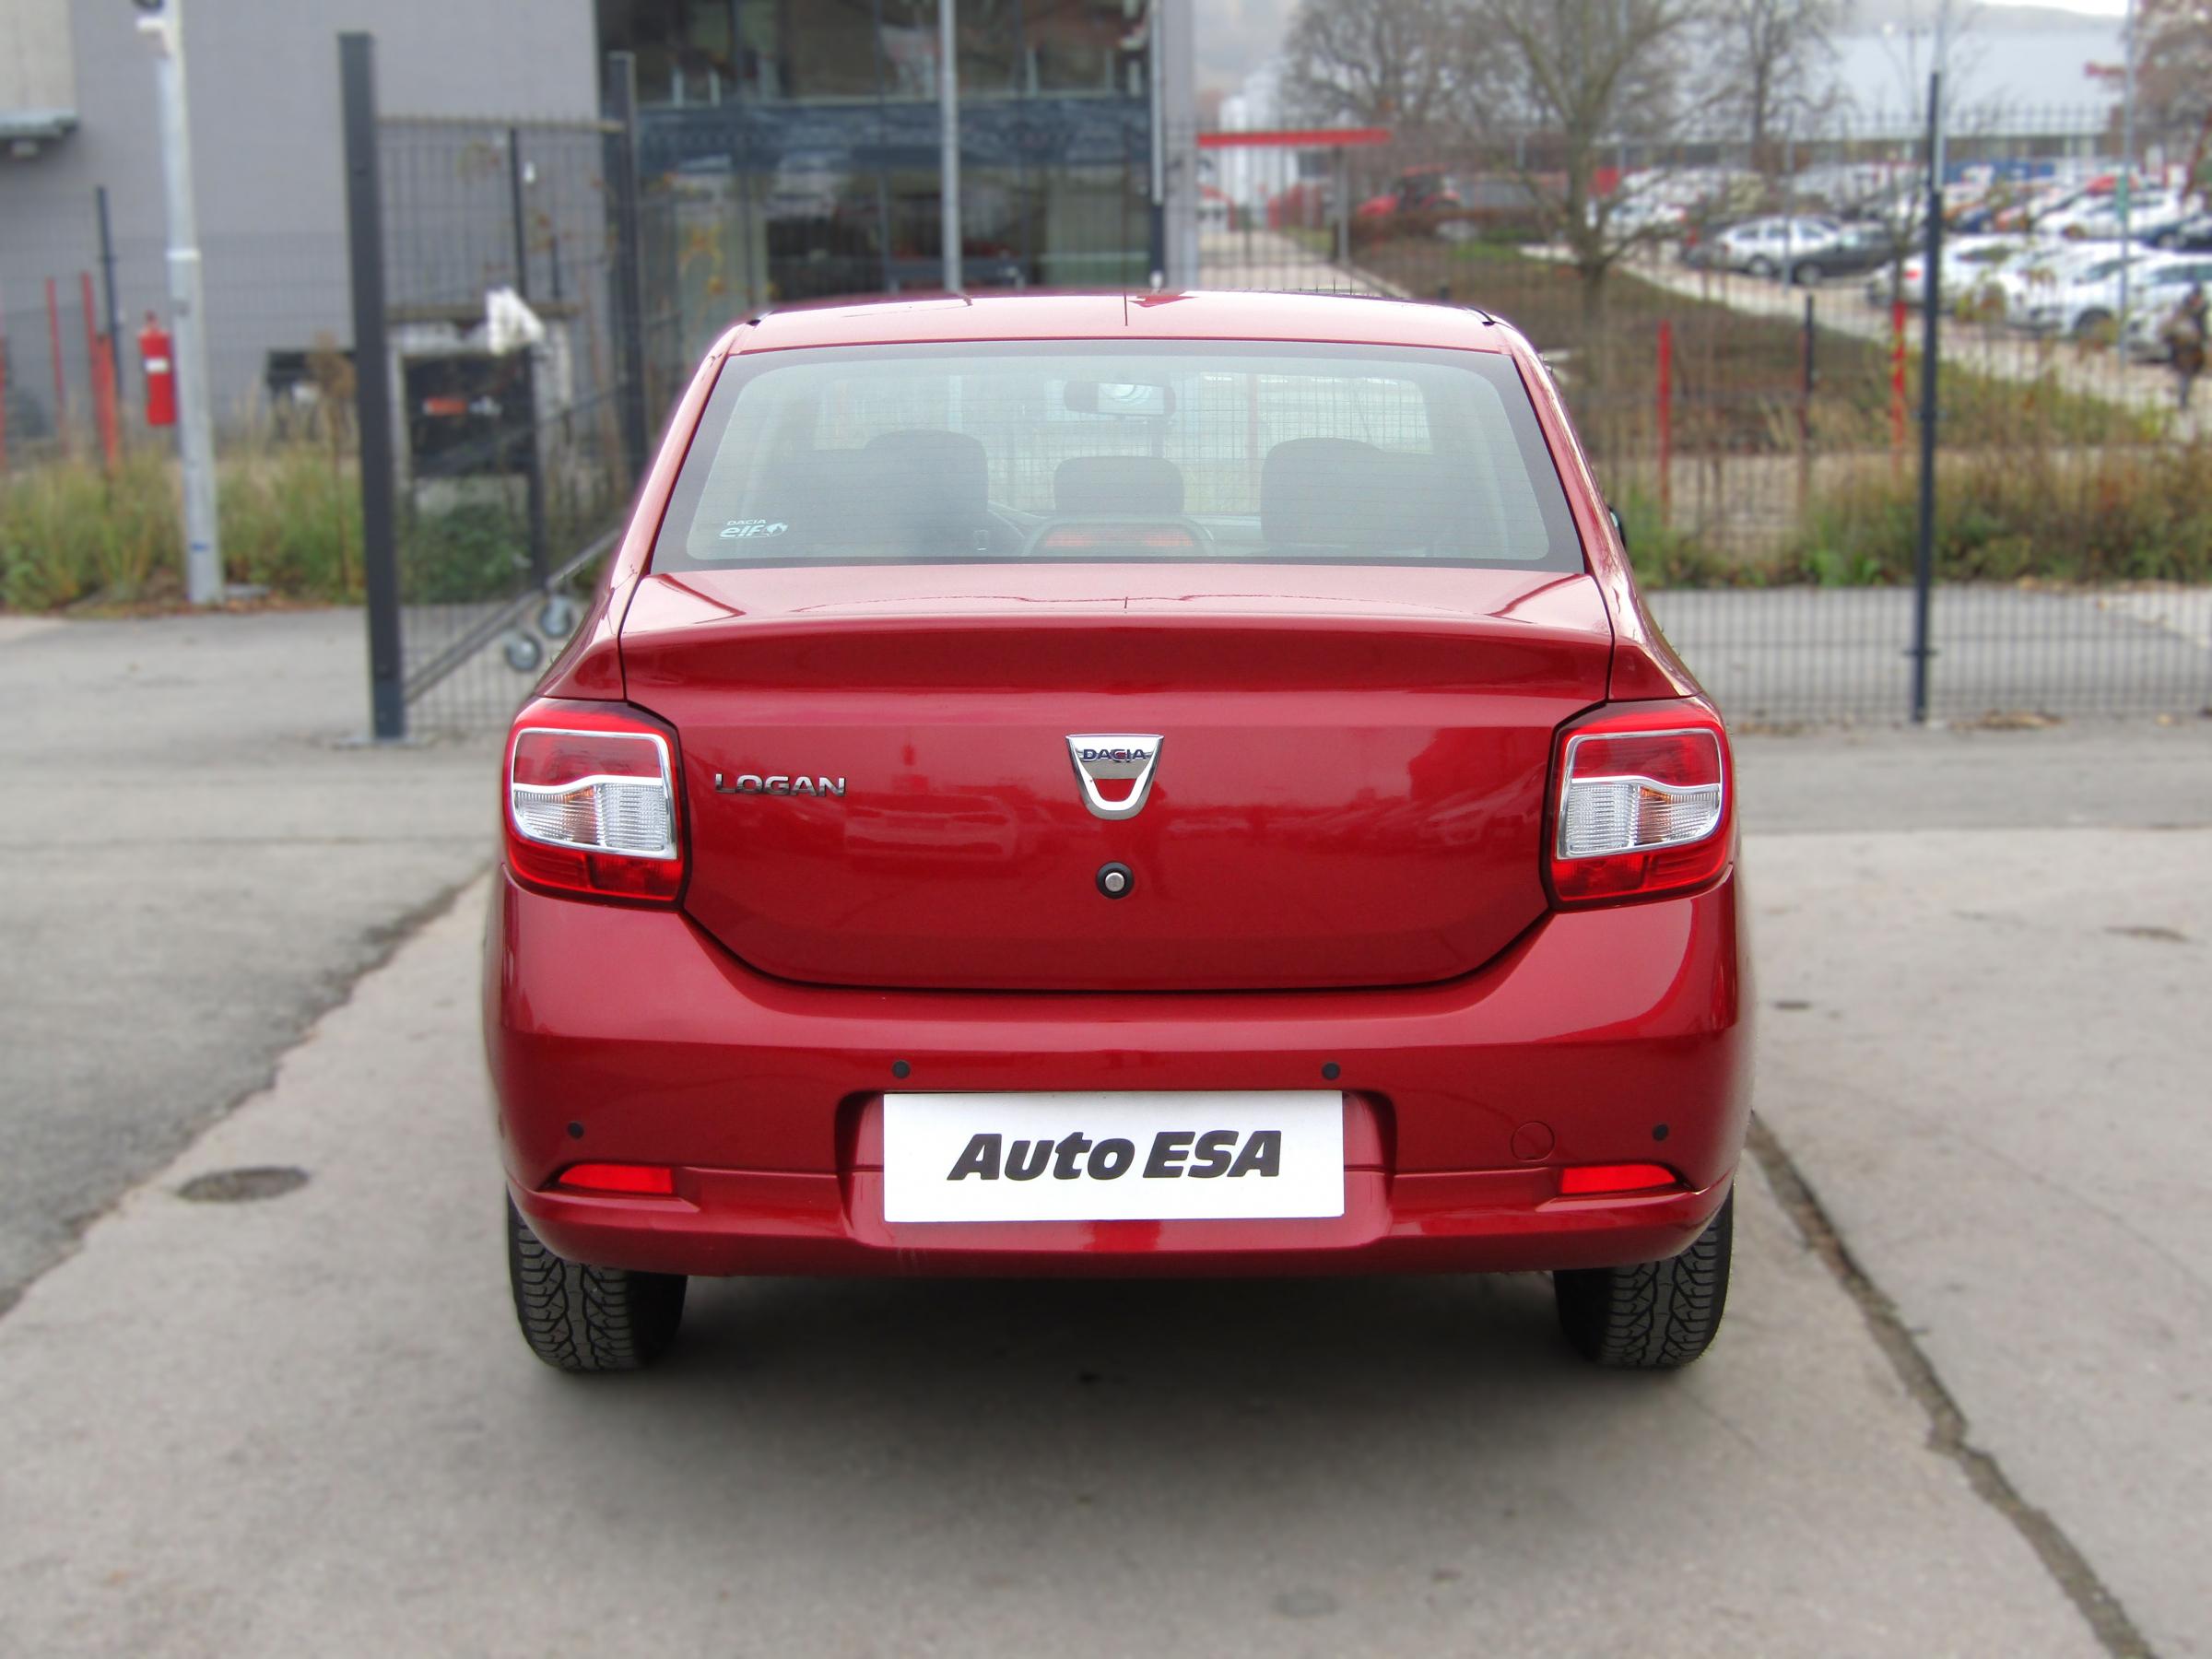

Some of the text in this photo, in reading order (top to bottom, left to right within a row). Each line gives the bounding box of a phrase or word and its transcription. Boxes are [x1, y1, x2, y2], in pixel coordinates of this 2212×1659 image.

[1083, 748, 1147, 762] DACIA
[715, 773, 845, 796] LOGAN
[947, 1130, 1281, 1181] Auto ESA
